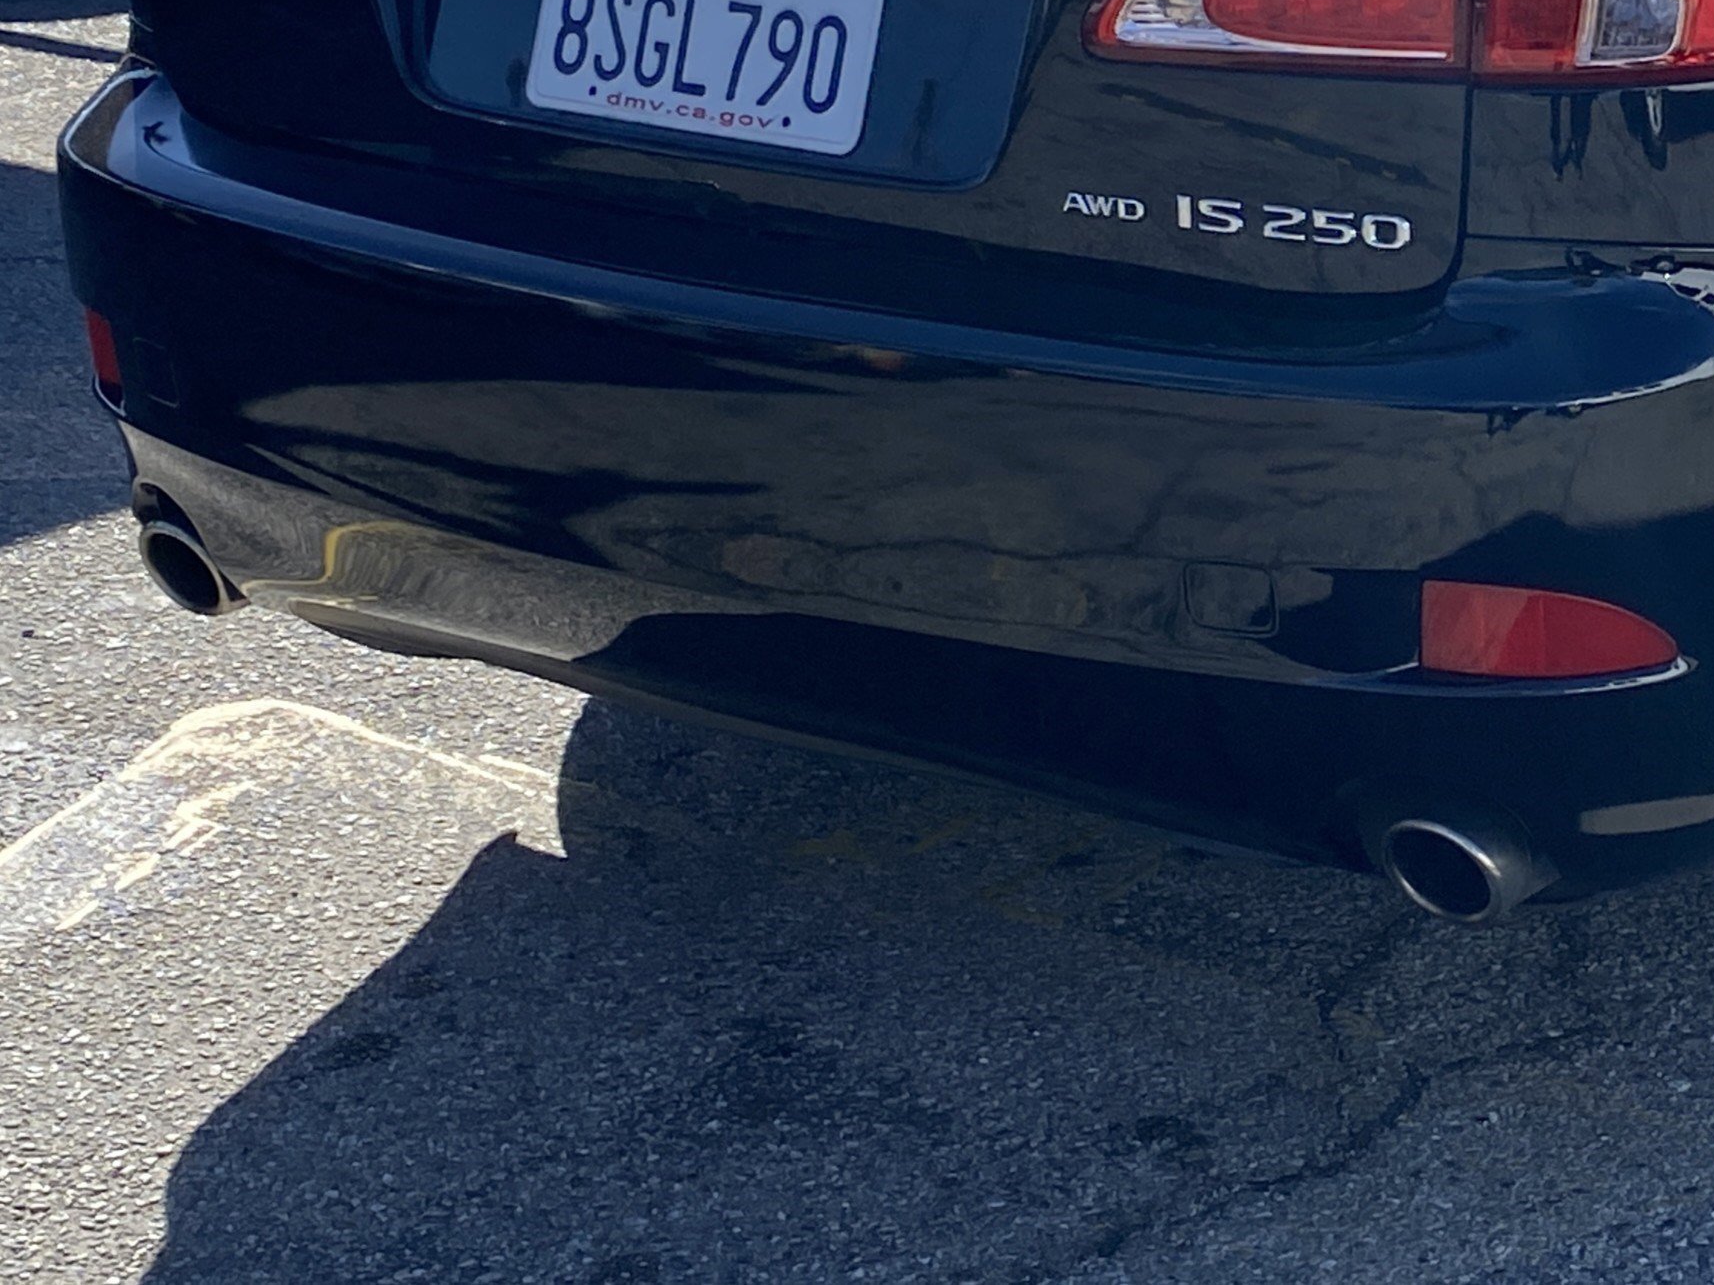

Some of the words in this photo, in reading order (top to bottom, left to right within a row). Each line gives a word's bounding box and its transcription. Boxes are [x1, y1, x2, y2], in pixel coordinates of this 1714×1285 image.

[606, 91, 774, 128] dmv.ca.gov
[1062, 191, 1146, 222] AWD
[1175, 193, 1245, 235] IS
[1262, 204, 1412, 250] 250
